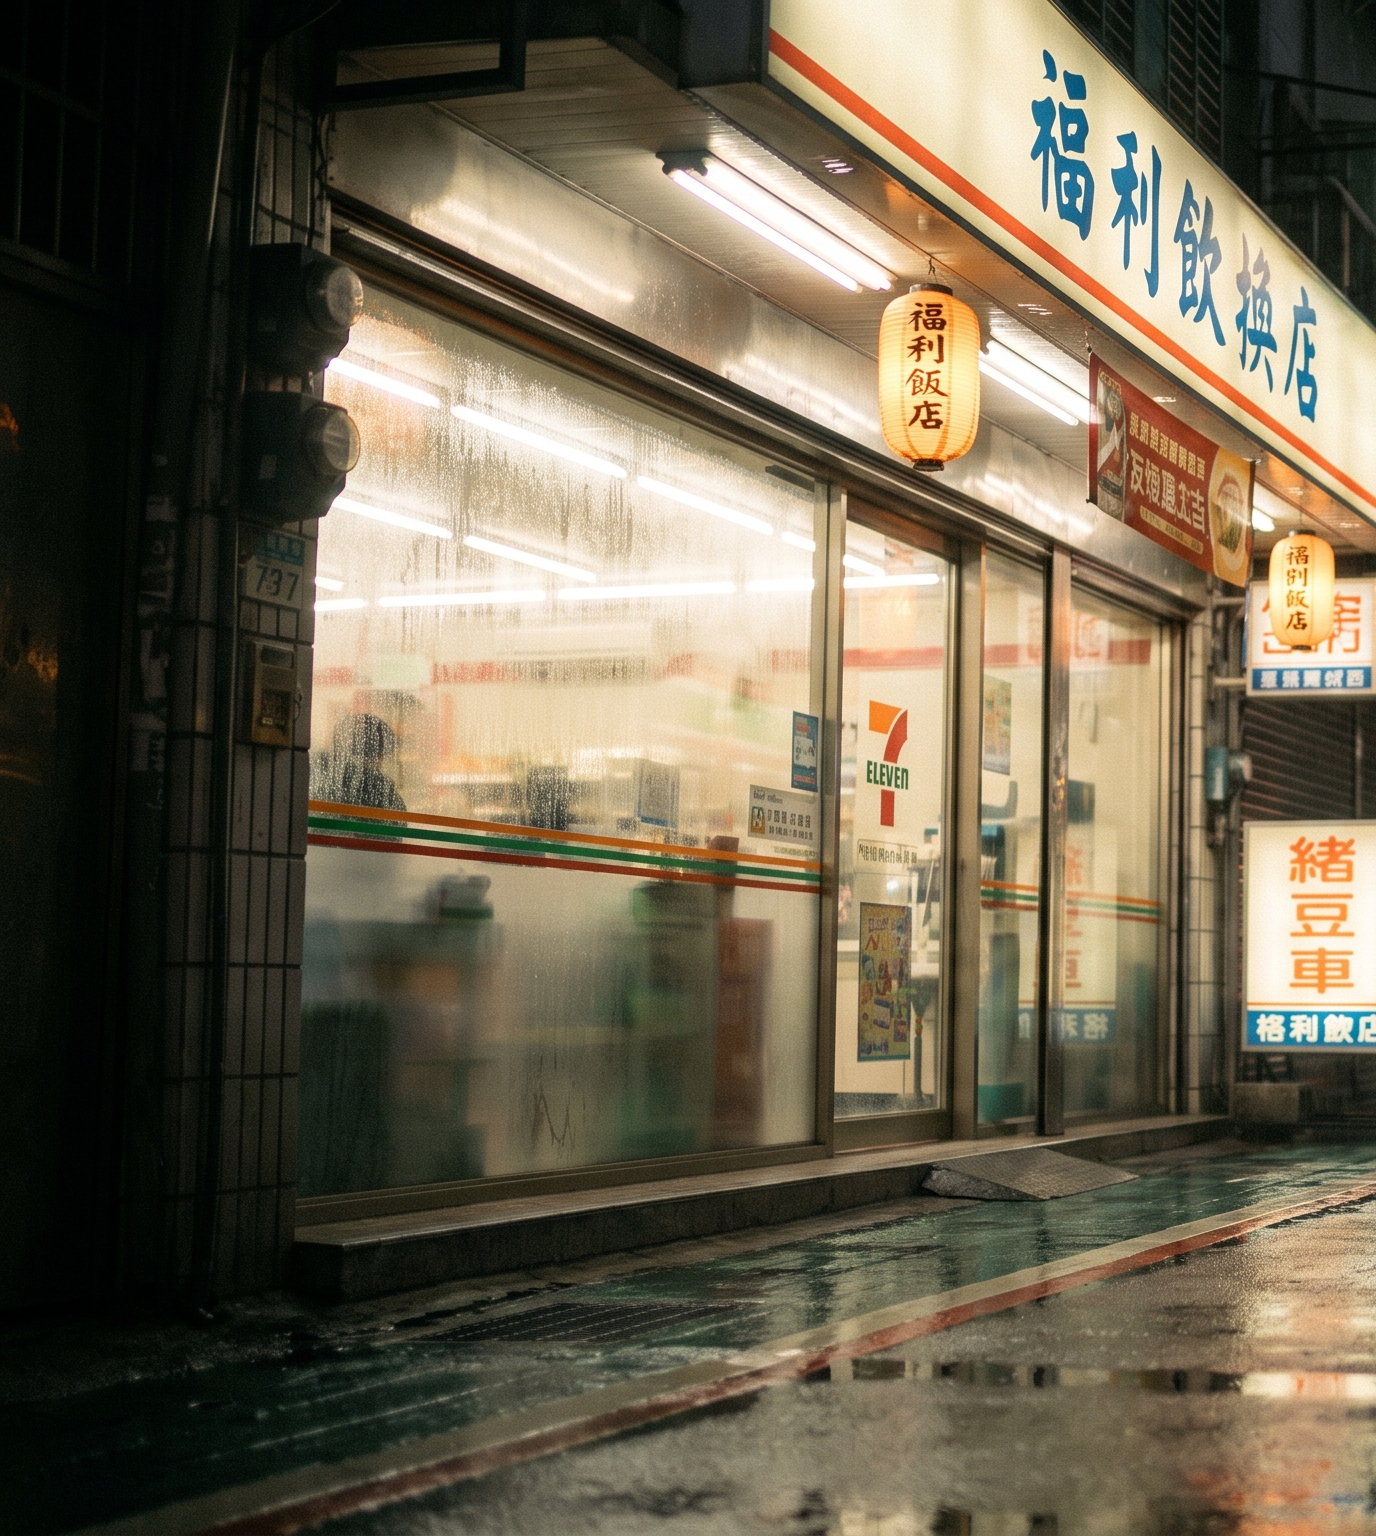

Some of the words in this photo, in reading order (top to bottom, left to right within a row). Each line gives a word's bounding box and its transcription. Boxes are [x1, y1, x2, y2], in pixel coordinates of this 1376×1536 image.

[906, 302, 949, 430] 福利飯店
[256, 563, 299, 602] 737
[868, 699, 908, 828] 7
